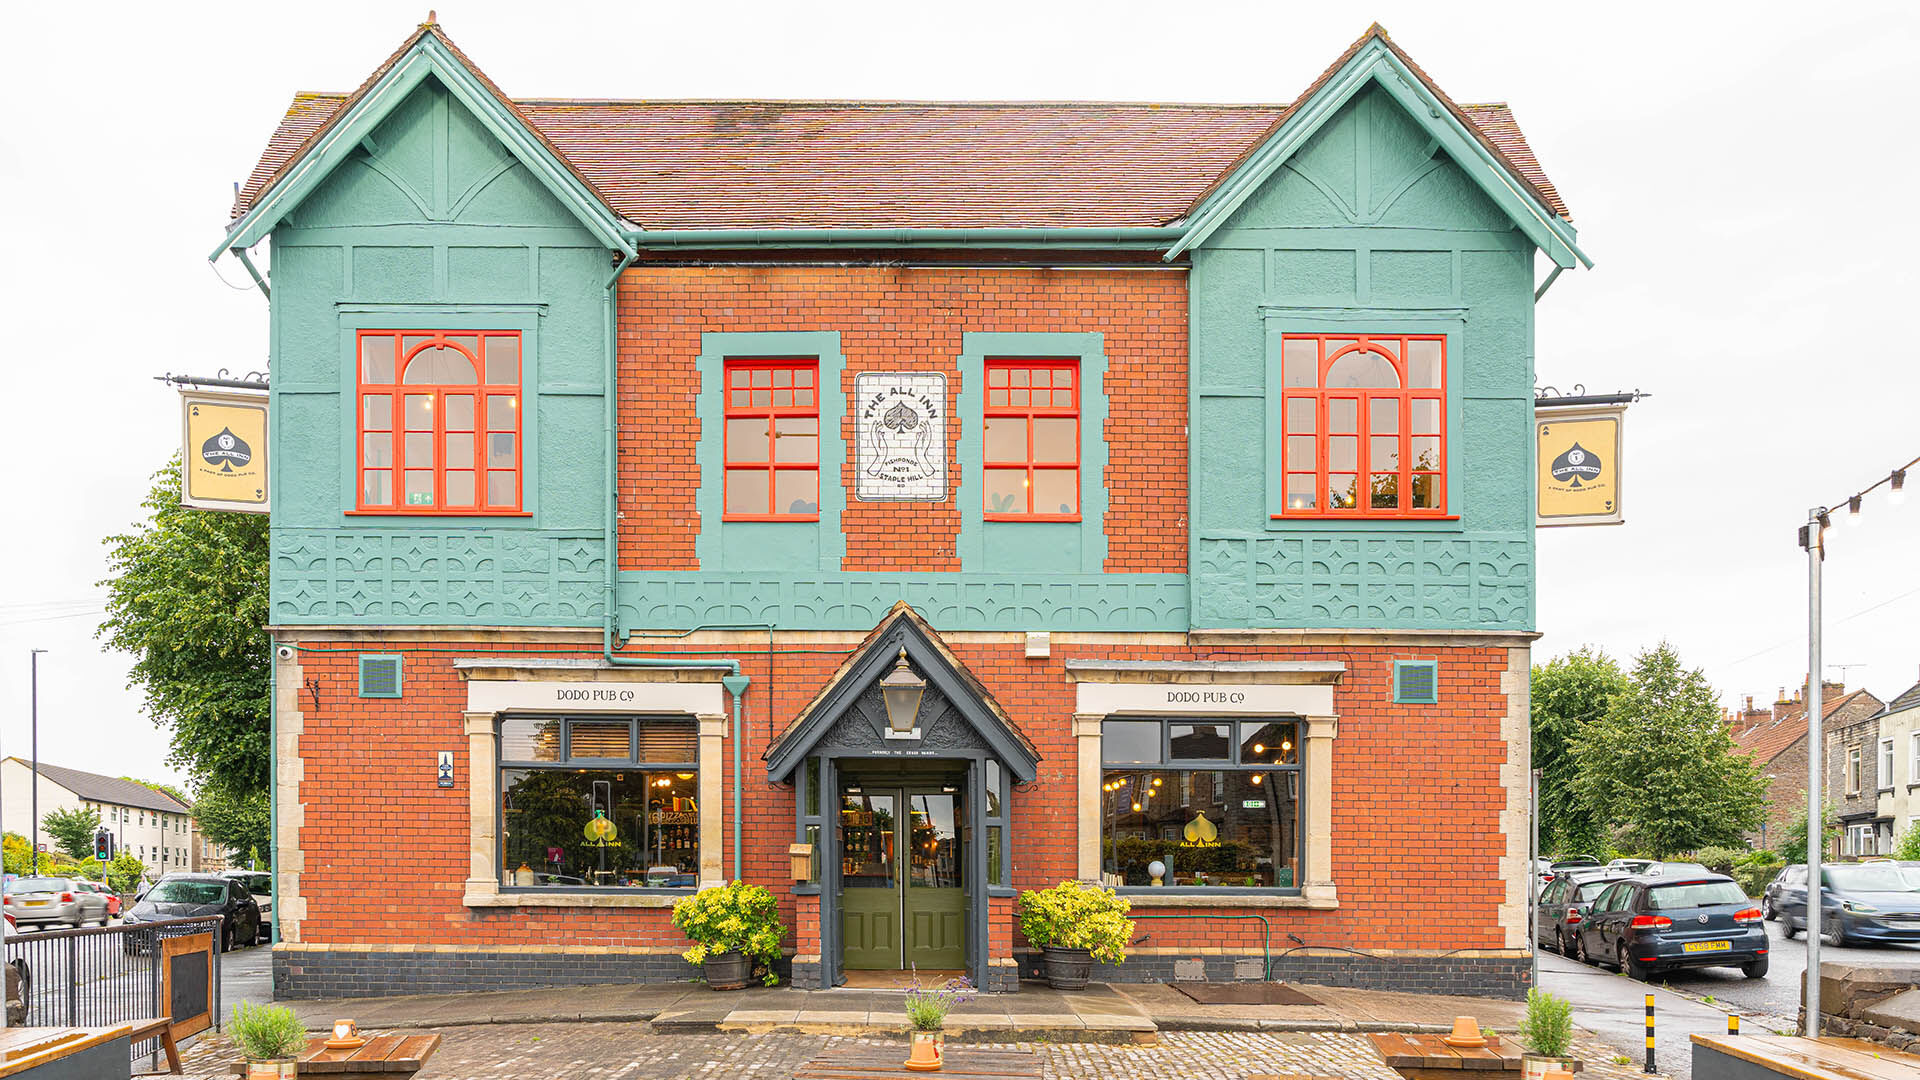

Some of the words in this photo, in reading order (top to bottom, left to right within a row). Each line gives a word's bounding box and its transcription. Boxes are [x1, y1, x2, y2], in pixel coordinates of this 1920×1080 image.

[864, 392, 886, 420] THE
[890, 386, 915, 398] ALL
[919, 395, 938, 419] INN
[907, 474, 923, 482] HILL
[557, 690, 590, 700] DODO
[593, 690, 617, 701] PUB
[1167, 692, 1200, 702] DODO
[1203, 692, 1227, 703] PUB
